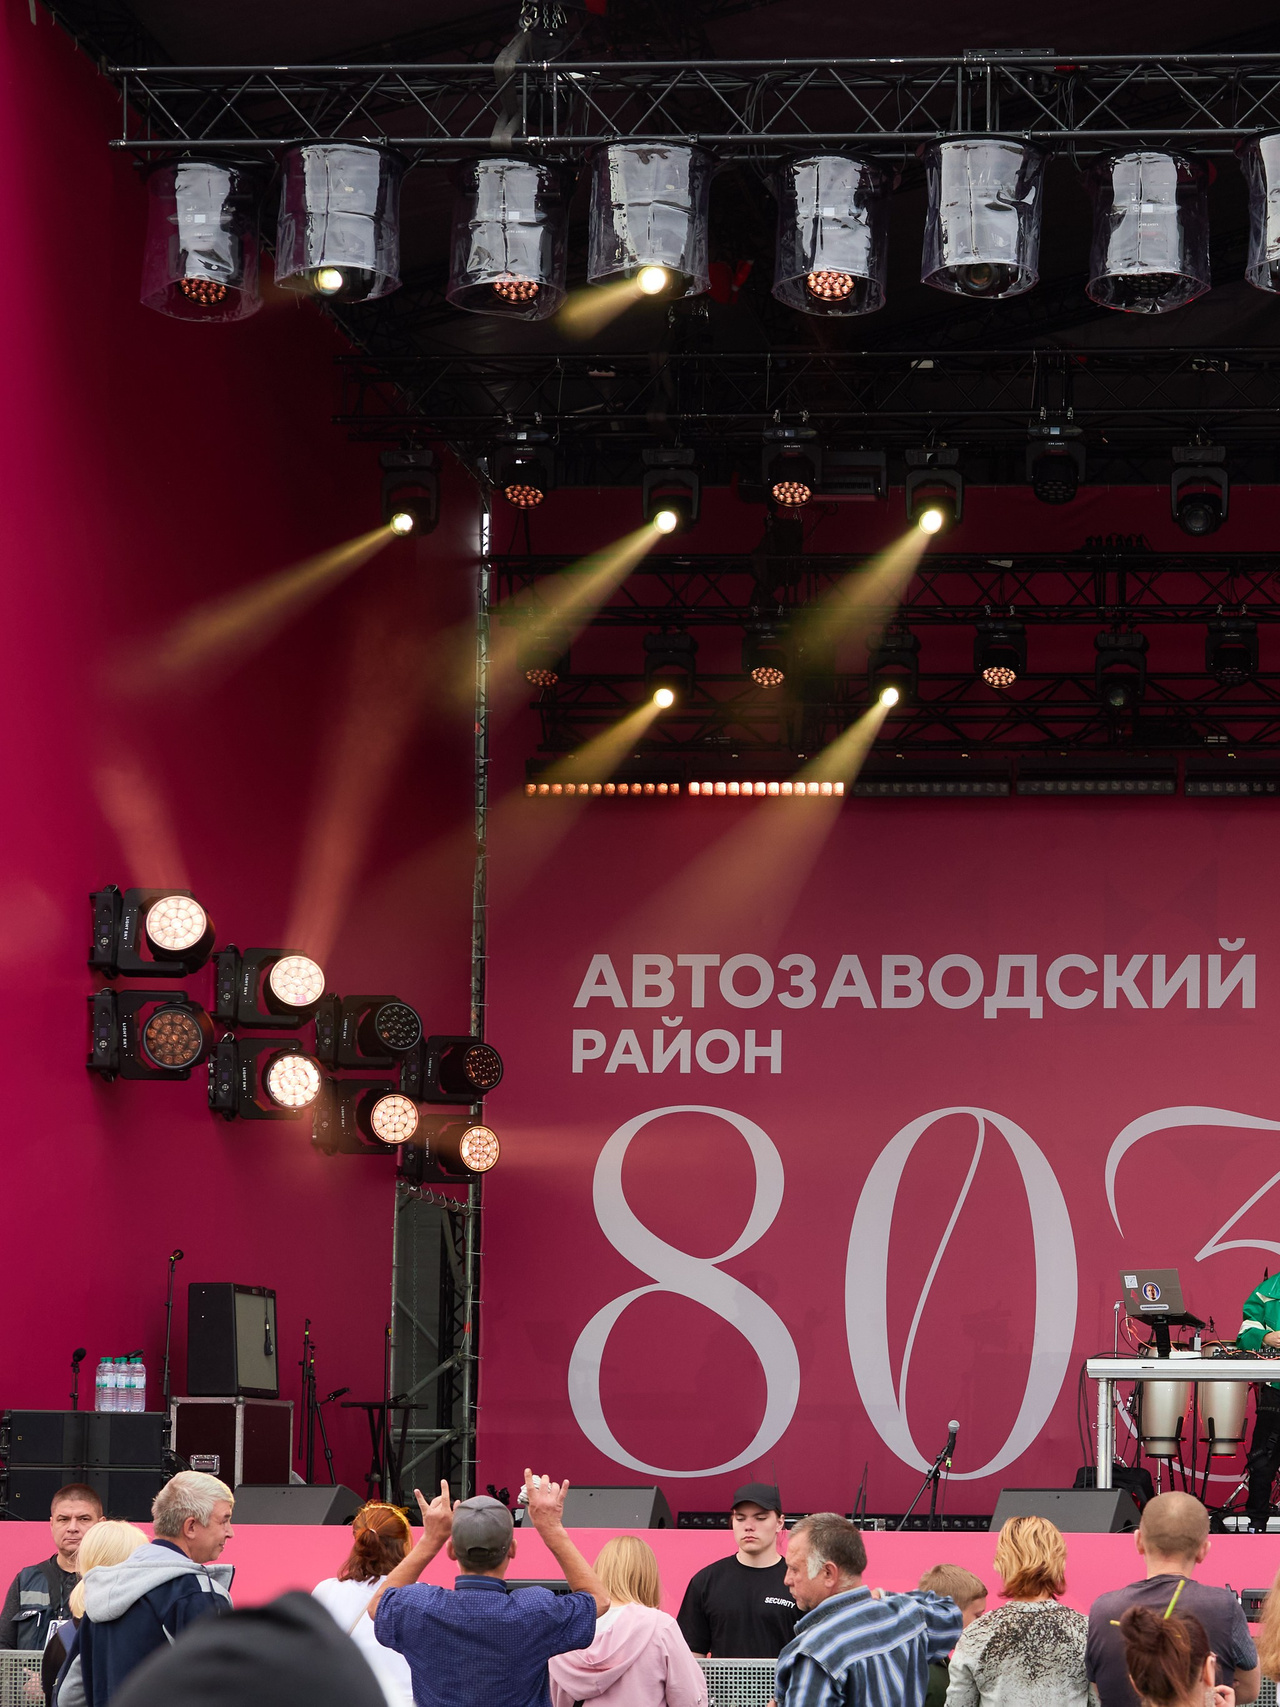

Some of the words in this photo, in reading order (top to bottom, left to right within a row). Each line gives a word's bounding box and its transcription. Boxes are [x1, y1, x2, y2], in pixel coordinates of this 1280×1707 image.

[573, 937, 1257, 1019] АВТОЗАВОДСКИЙ
[571, 1016, 783, 1074] РАЙОН
[764, 1596, 795, 1609] SECURITY
